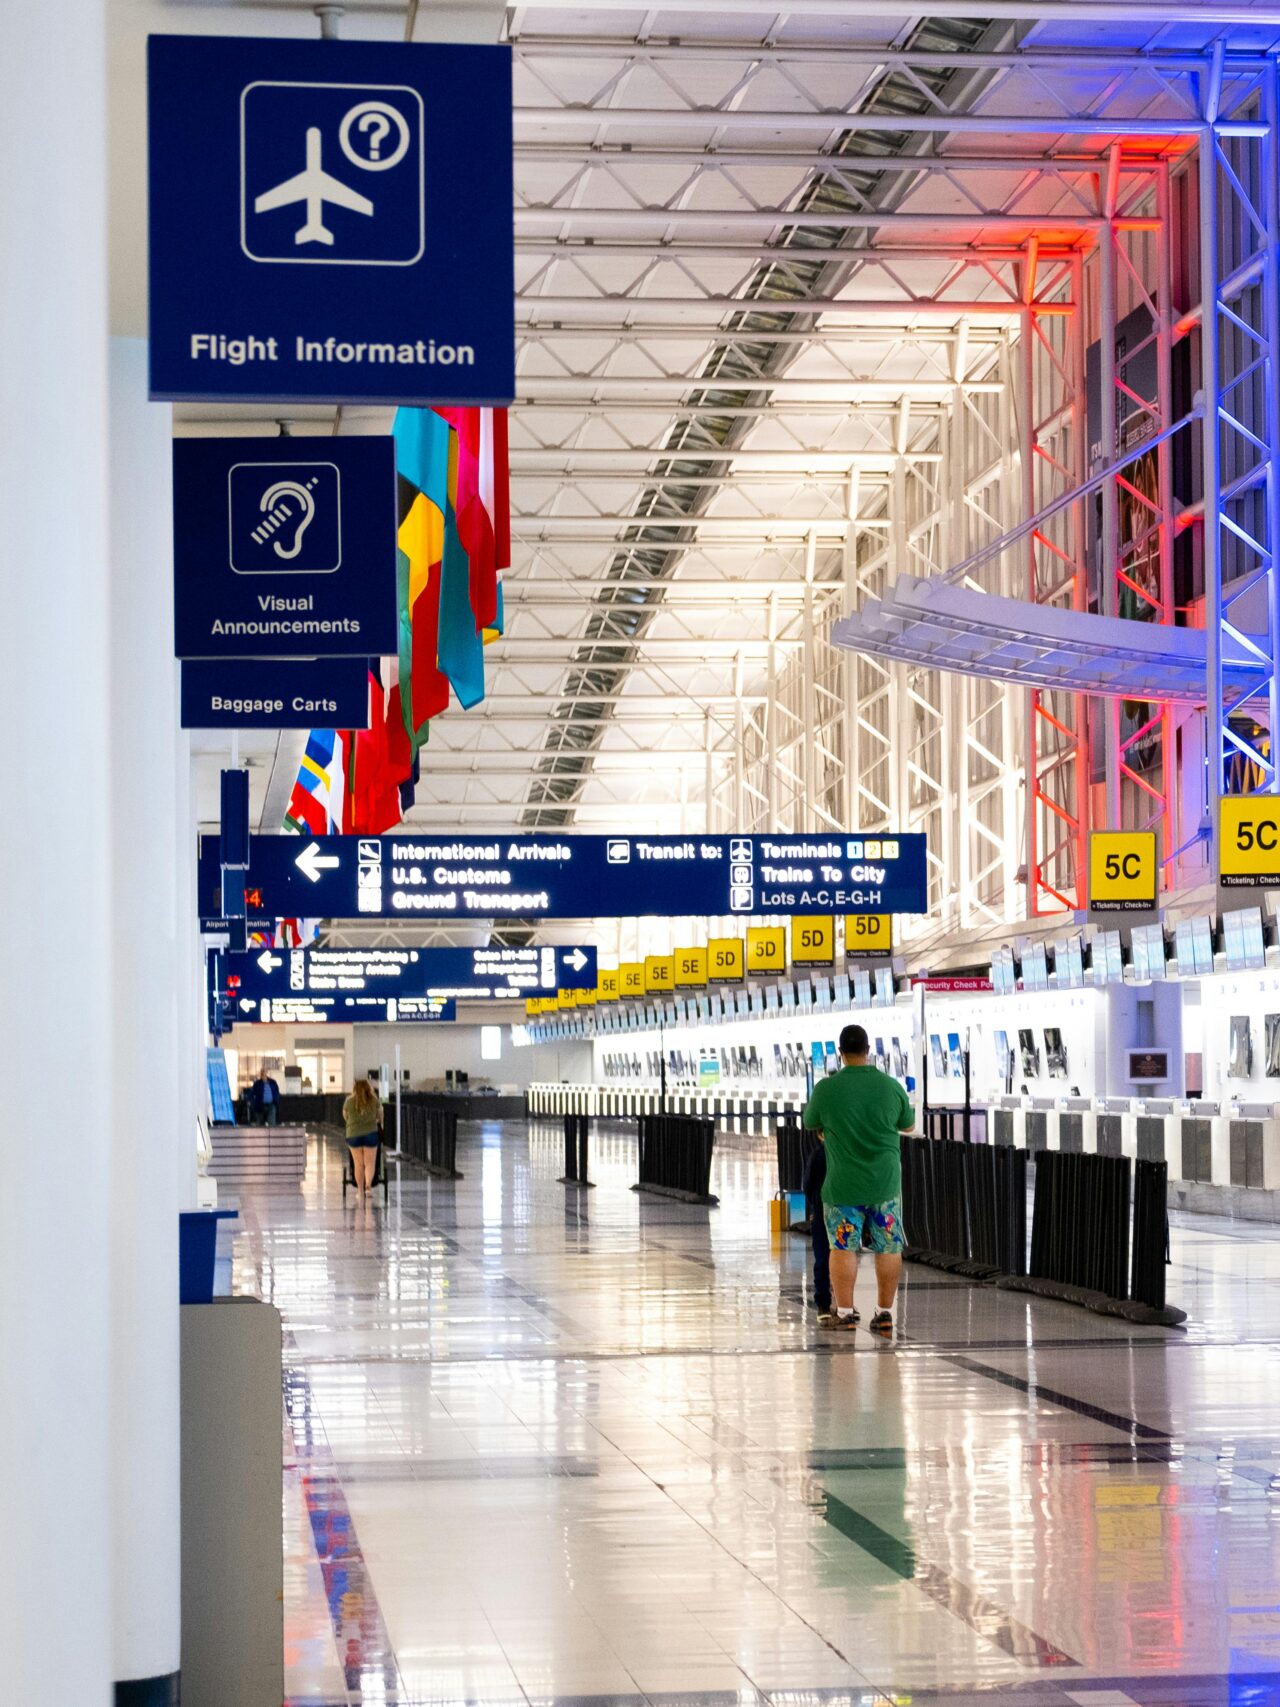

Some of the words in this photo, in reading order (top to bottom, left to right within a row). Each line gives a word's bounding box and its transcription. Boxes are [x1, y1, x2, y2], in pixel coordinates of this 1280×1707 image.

[190, 333, 278, 366] Flight
[296, 336, 475, 366] Information
[258, 595, 313, 611] Visual
[211, 617, 361, 635] Announcements
[211, 696, 284, 713] Baggage
[292, 697, 337, 712] Carts
[1236, 820, 1278, 851] 5C
[392, 843, 500, 860] International
[507, 843, 571, 860] Arrivals
[636, 843, 695, 859] Transit
[700, 843, 722, 859] to:
[761, 842, 842, 858] Terminals
[761, 866, 813, 882] Trains
[821, 866, 842, 882] To
[851, 865, 886, 884] City
[1105, 853, 1141, 880] 5C
[392, 867, 427, 884] U.S.
[434, 867, 511, 884] Customs
[1226, 876, 1255, 886] Ticketing
[392, 891, 457, 909] Ground
[463, 891, 548, 911] Transport
[761, 891, 795, 905] Lots
[1096, 902, 1120, 910] Ticketing
[206, 920, 229, 929] Airport
[856, 916, 880, 935] 5D
[801, 930, 824, 947] 5D
[756, 941, 776, 957] 5D
[682, 960, 698, 974] 5E
[716, 952, 735, 966] 5D
[626, 973, 640, 986] 5E
[652, 967, 668, 980] 5E
[602, 979, 616, 991] 5E
[954, 980, 978, 988] Check
